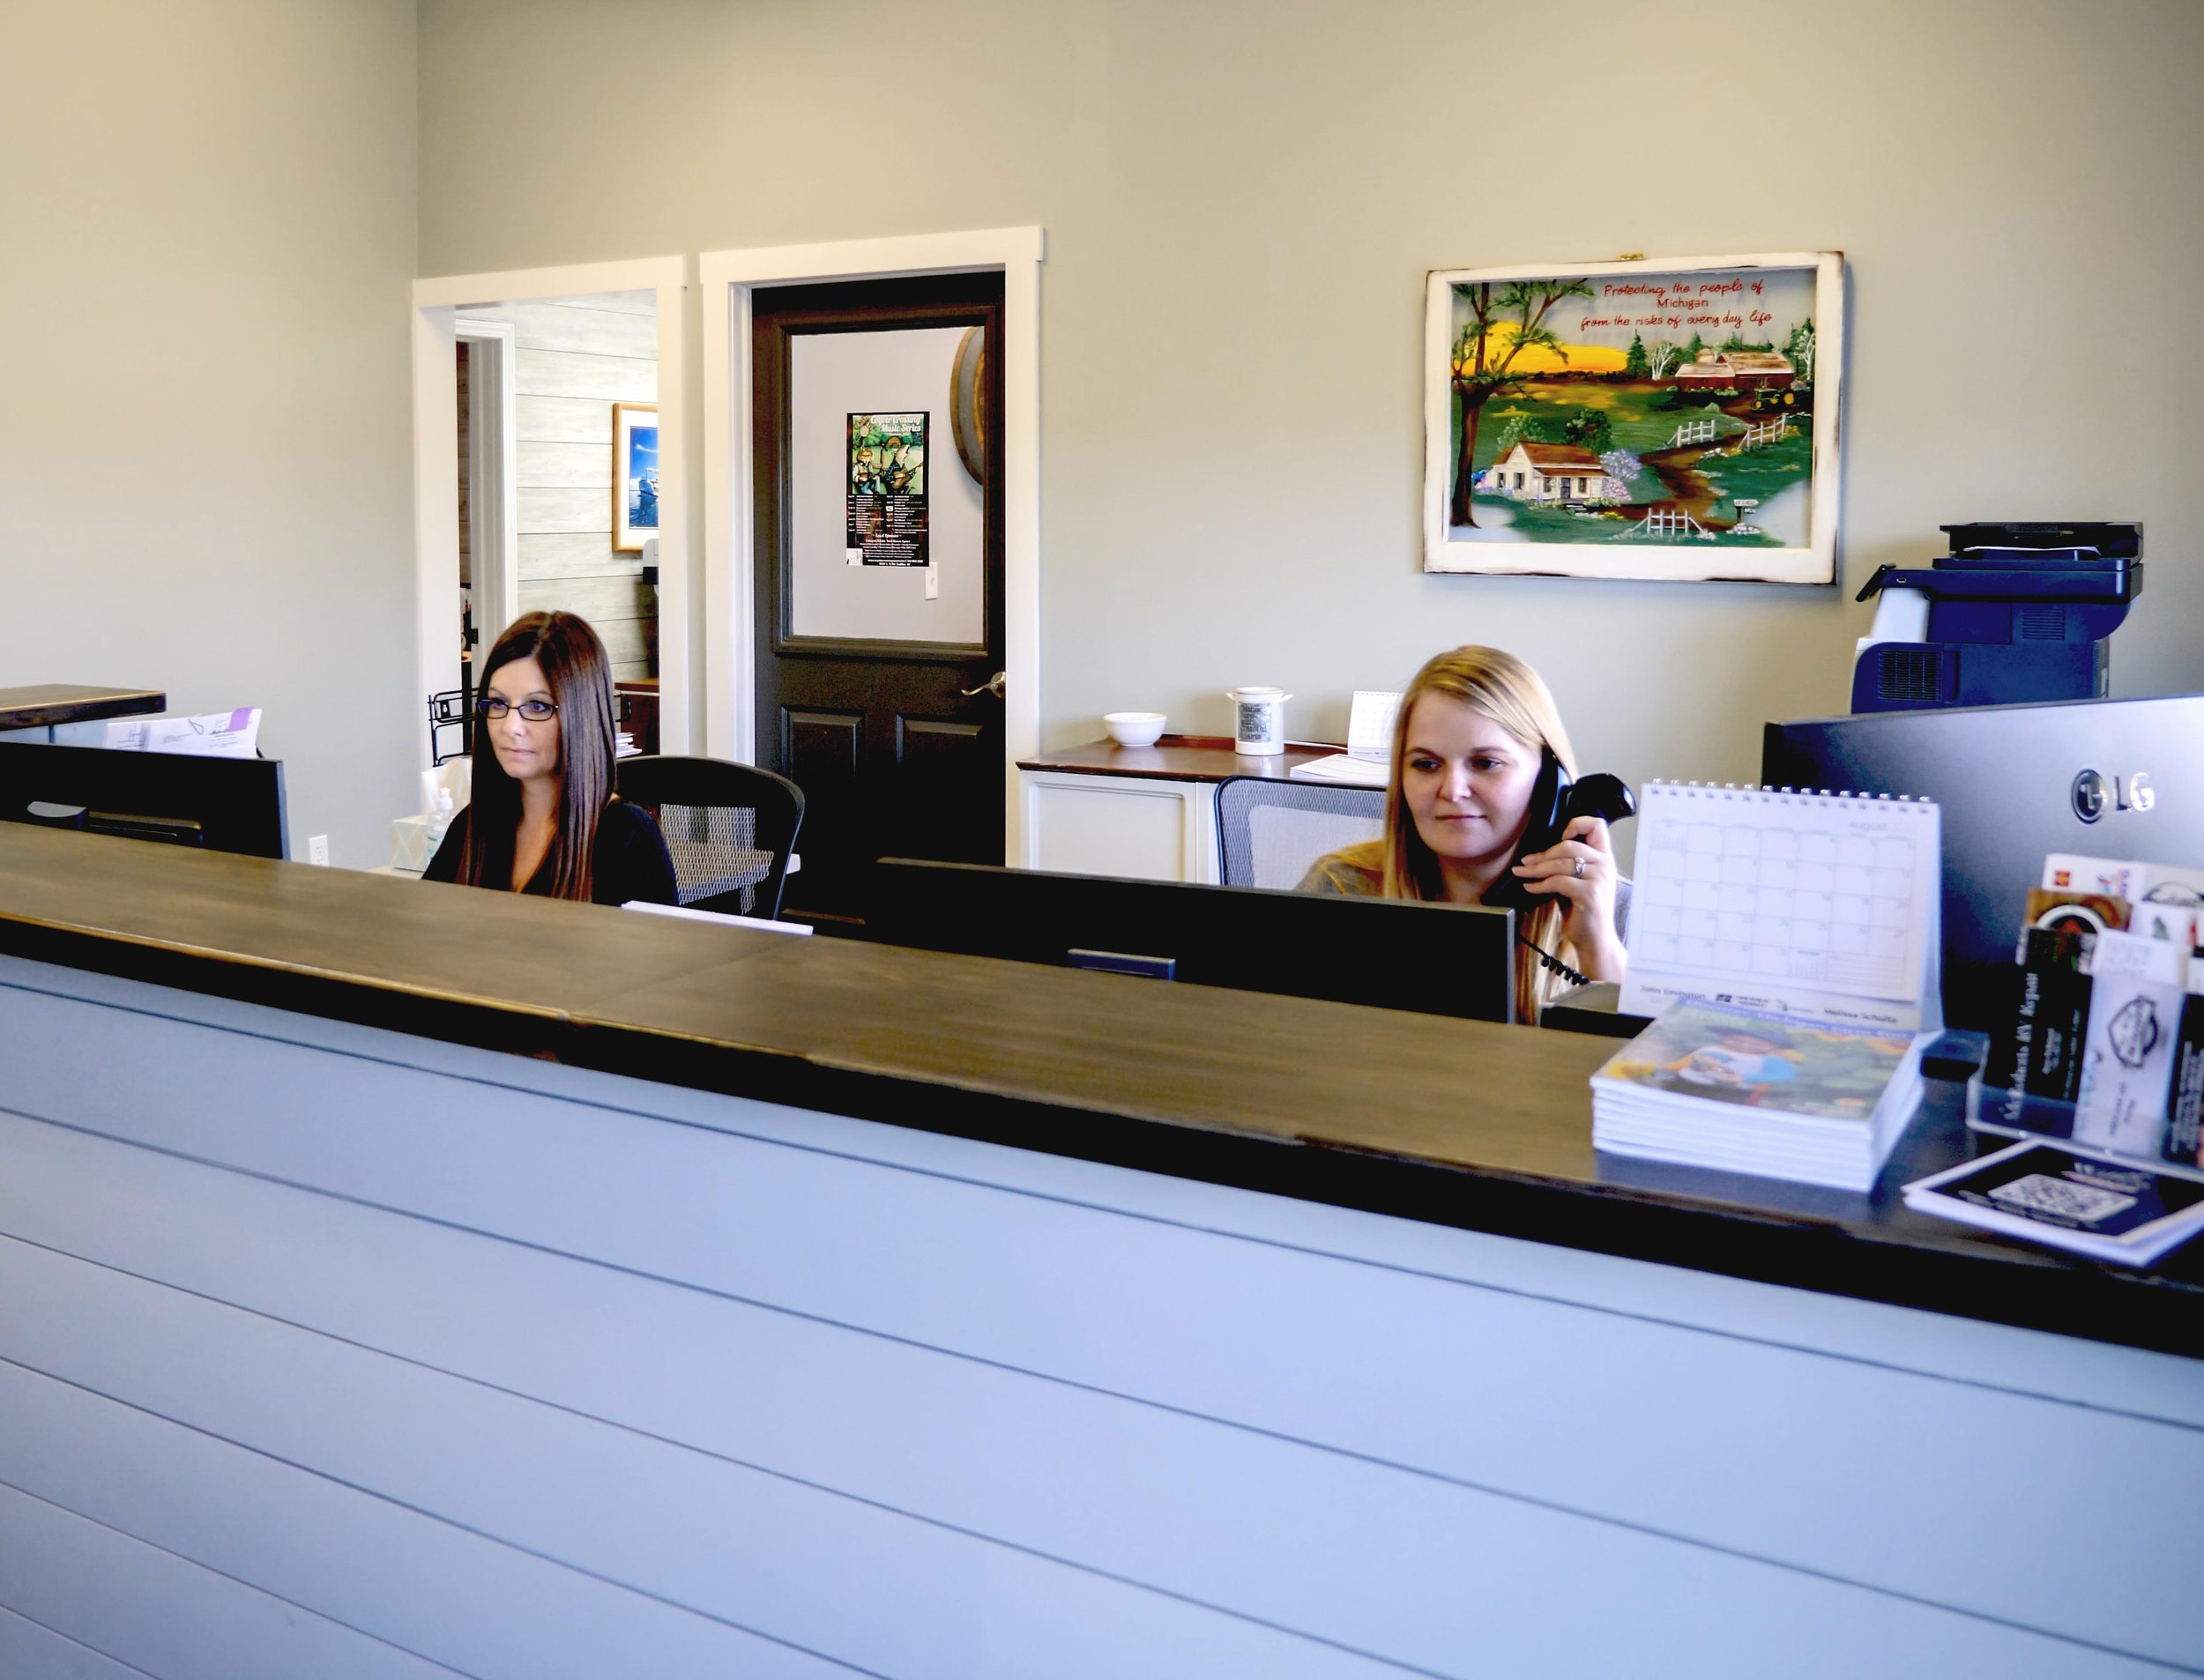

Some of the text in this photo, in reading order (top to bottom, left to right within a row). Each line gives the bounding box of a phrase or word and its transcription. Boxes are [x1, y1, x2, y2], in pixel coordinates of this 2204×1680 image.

[1604, 279, 1764, 297] Protecting the people of
[1657, 298, 1709, 310] Michigan
[1580, 316, 1612, 331] from
[1614, 315, 1629, 326] the
[1635, 314, 1663, 326] risks
[1667, 314, 1682, 329] of
[1749, 309, 1772, 326] life
[882, 423, 922, 433] Music Series
[1848, 821, 1888, 832] August
[1640, 985, 1661, 994] John
[1823, 1008, 1858, 1019] Melissa
